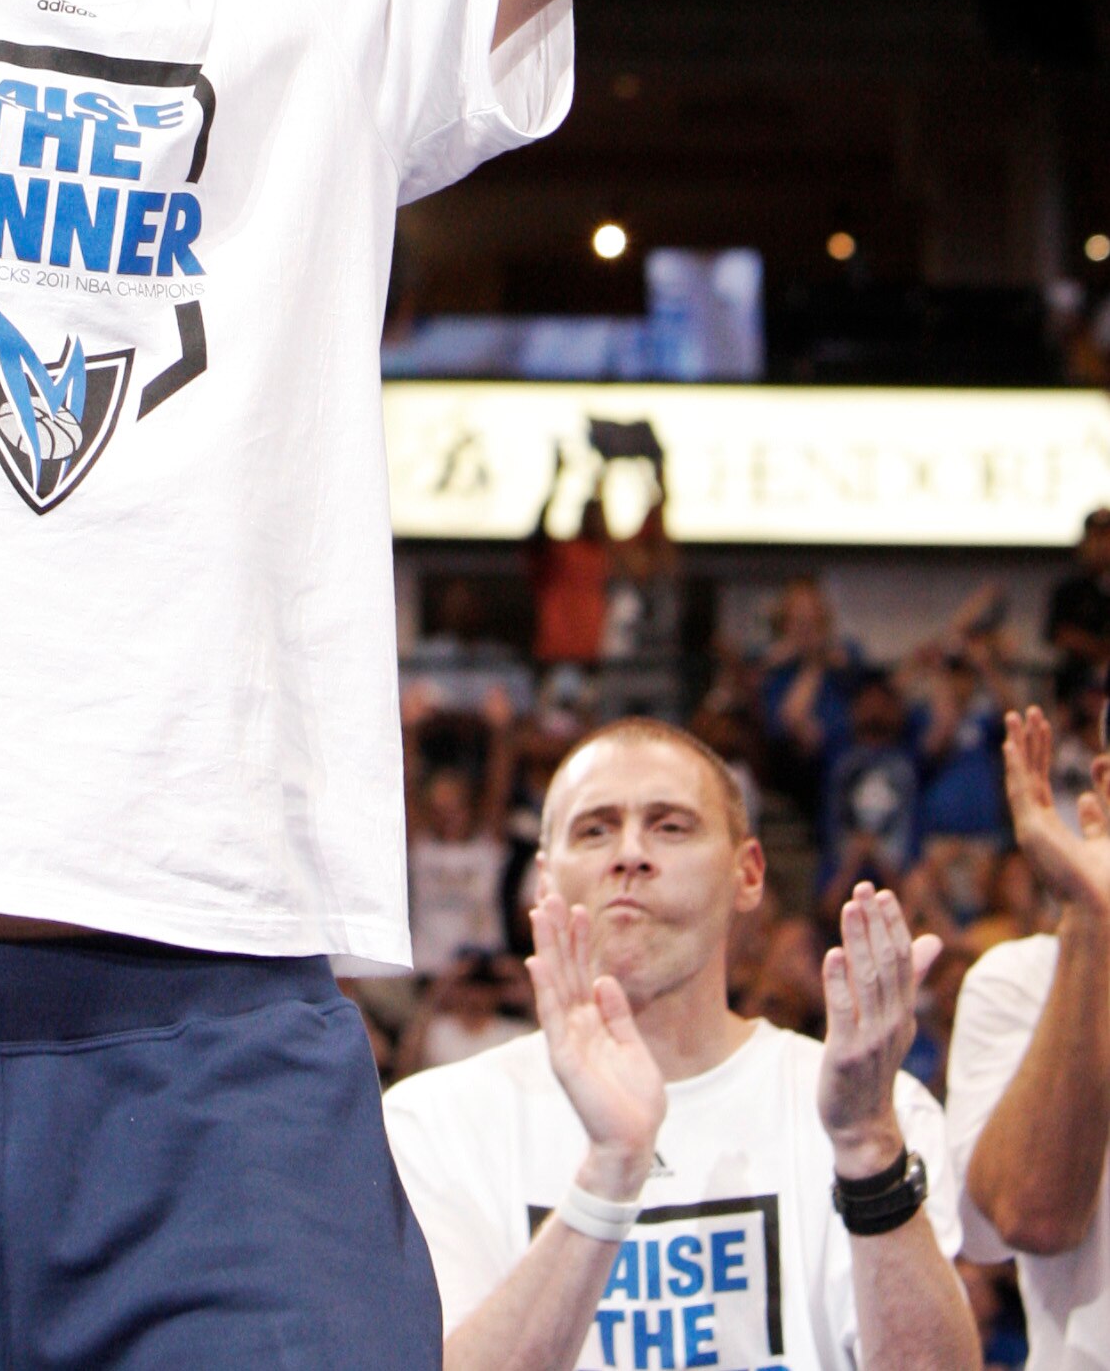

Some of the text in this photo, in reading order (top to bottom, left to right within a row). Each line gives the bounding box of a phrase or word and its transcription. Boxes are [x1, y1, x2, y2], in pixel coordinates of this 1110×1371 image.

[36, 270, 70, 290] 2011
[75, 275, 112, 295] NBA
[116, 280, 206, 299] CHAMPIONS
[601, 1229, 749, 1301] AISE
[594, 1302, 719, 1370] THE
